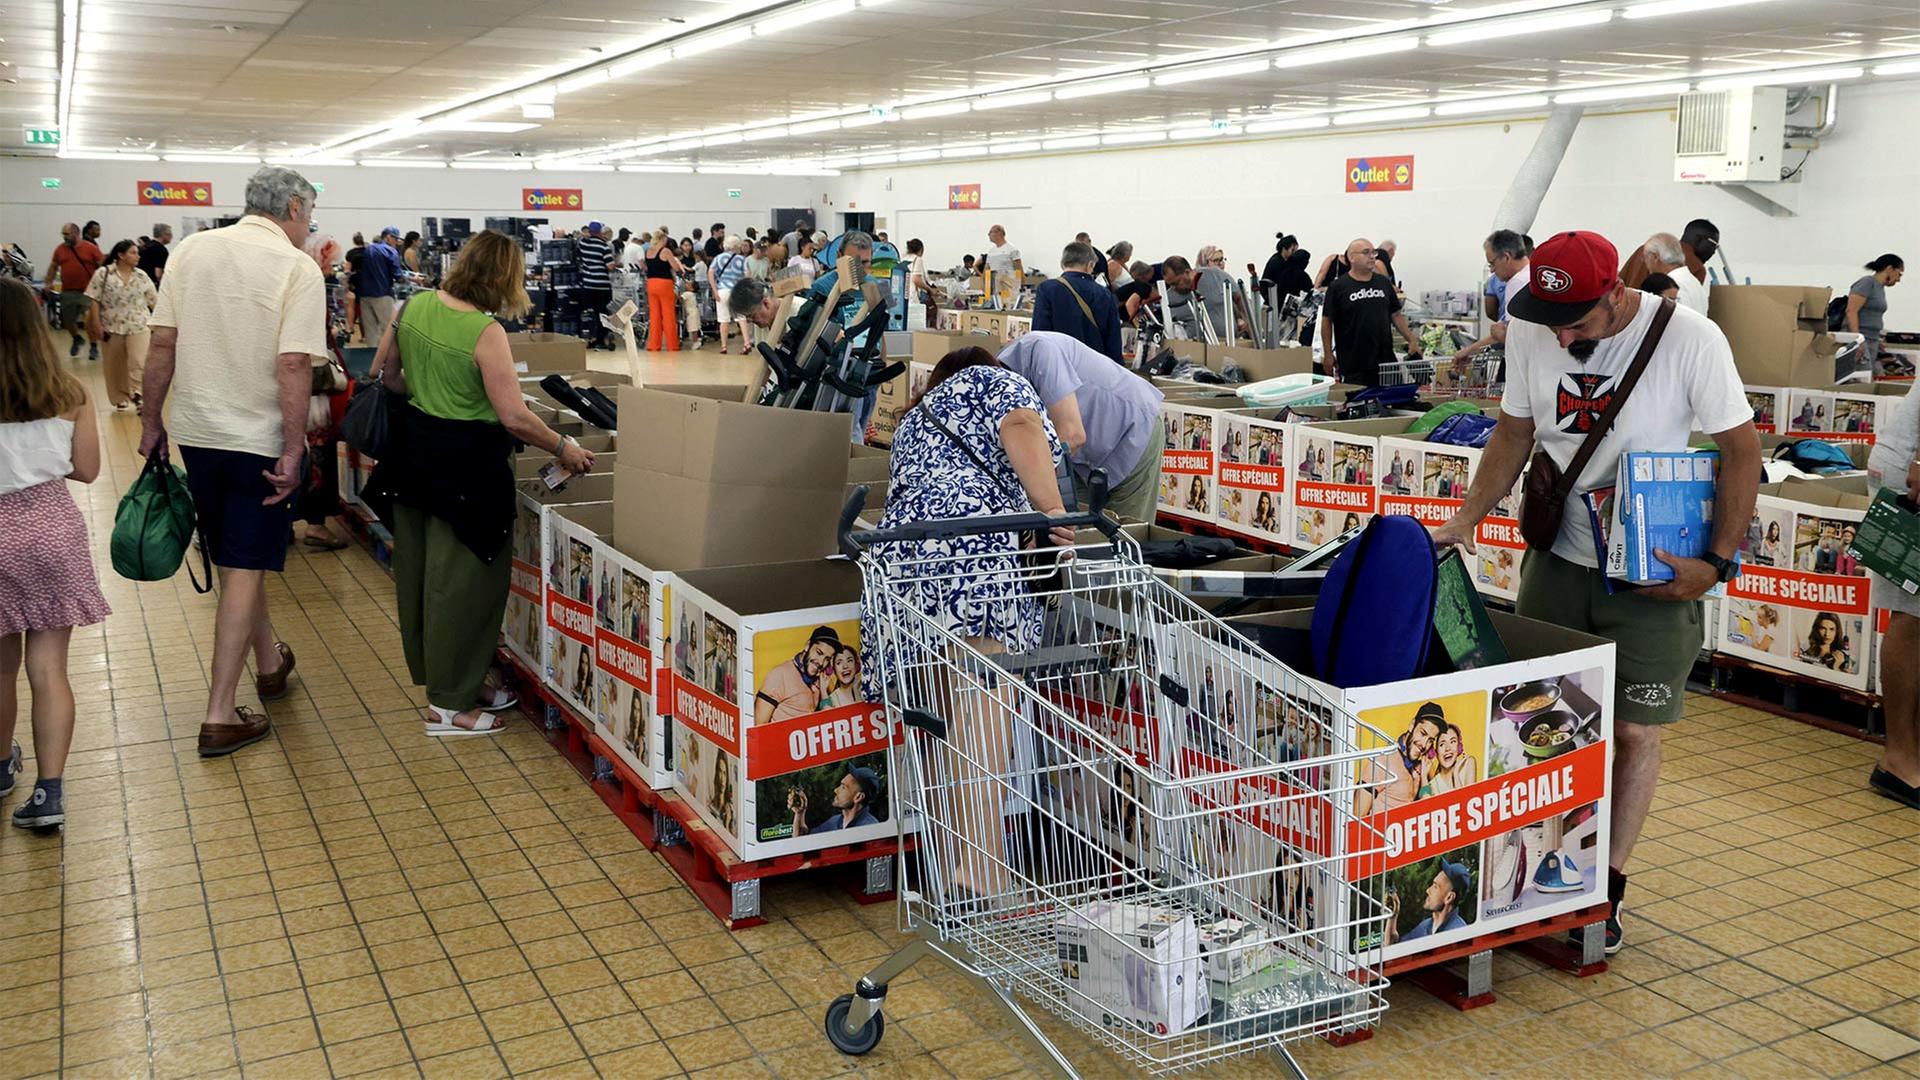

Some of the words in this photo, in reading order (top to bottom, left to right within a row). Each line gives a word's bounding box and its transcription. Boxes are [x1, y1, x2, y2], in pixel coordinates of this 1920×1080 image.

[1350, 166, 1390, 184] Outlet
[143, 187, 188, 200] Outlet
[527, 193, 563, 205] Outlet
[951, 191, 969, 203] Outlet
[1349, 287, 1385, 302] adidas
[1177, 454, 1209, 470] SPÉCIALE
[1222, 469, 1241, 483] OFFRE
[1241, 469, 1279, 487] SPÉCIALE
[1300, 487, 1324, 504] OFFRE
[1325, 486, 1368, 506] SPÉCIALE
[1384, 502, 1413, 516] OFFRE
[1482, 523, 1511, 541] OFFRE
[1614, 543, 1624, 571] CRIVIT
[1735, 573, 1777, 598] OFFRE
[1780, 574, 1857, 606] SPÉCIALE
[599, 637, 616, 669] OFFRE
[616, 644, 648, 682] SPÉCIALE
[677, 687, 698, 724] OFFRE
[698, 701, 735, 743] SPÉCIALE
[788, 713, 866, 761] OFFRE
[1387, 806, 1462, 859] OFFRE
[1467, 765, 1573, 832] SPÉCIALE
